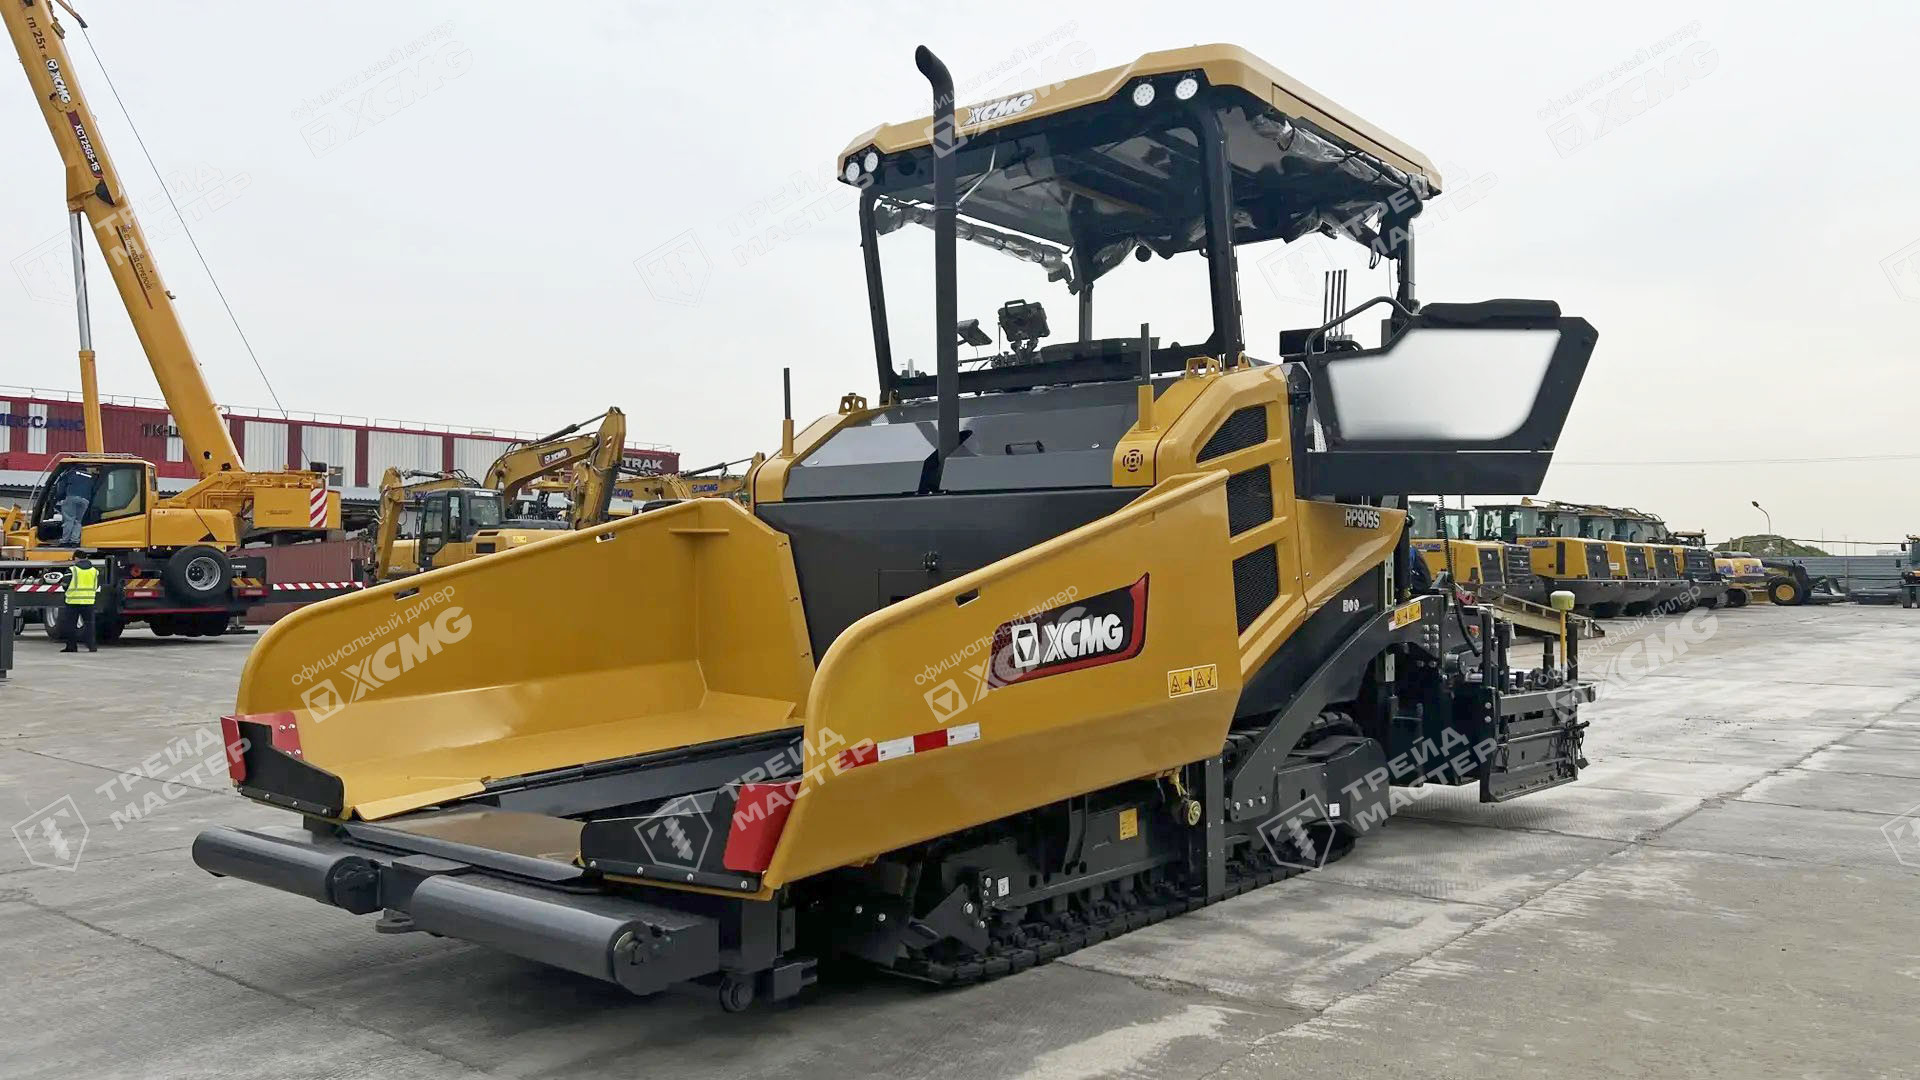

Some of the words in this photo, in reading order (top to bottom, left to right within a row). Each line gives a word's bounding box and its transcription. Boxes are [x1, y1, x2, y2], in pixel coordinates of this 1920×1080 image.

[51, 68, 72, 104] XCMG
[963, 93, 1034, 126] XCMG
[1344, 509, 1381, 528] RP905S
[1043, 613, 1124, 664] XCMG
